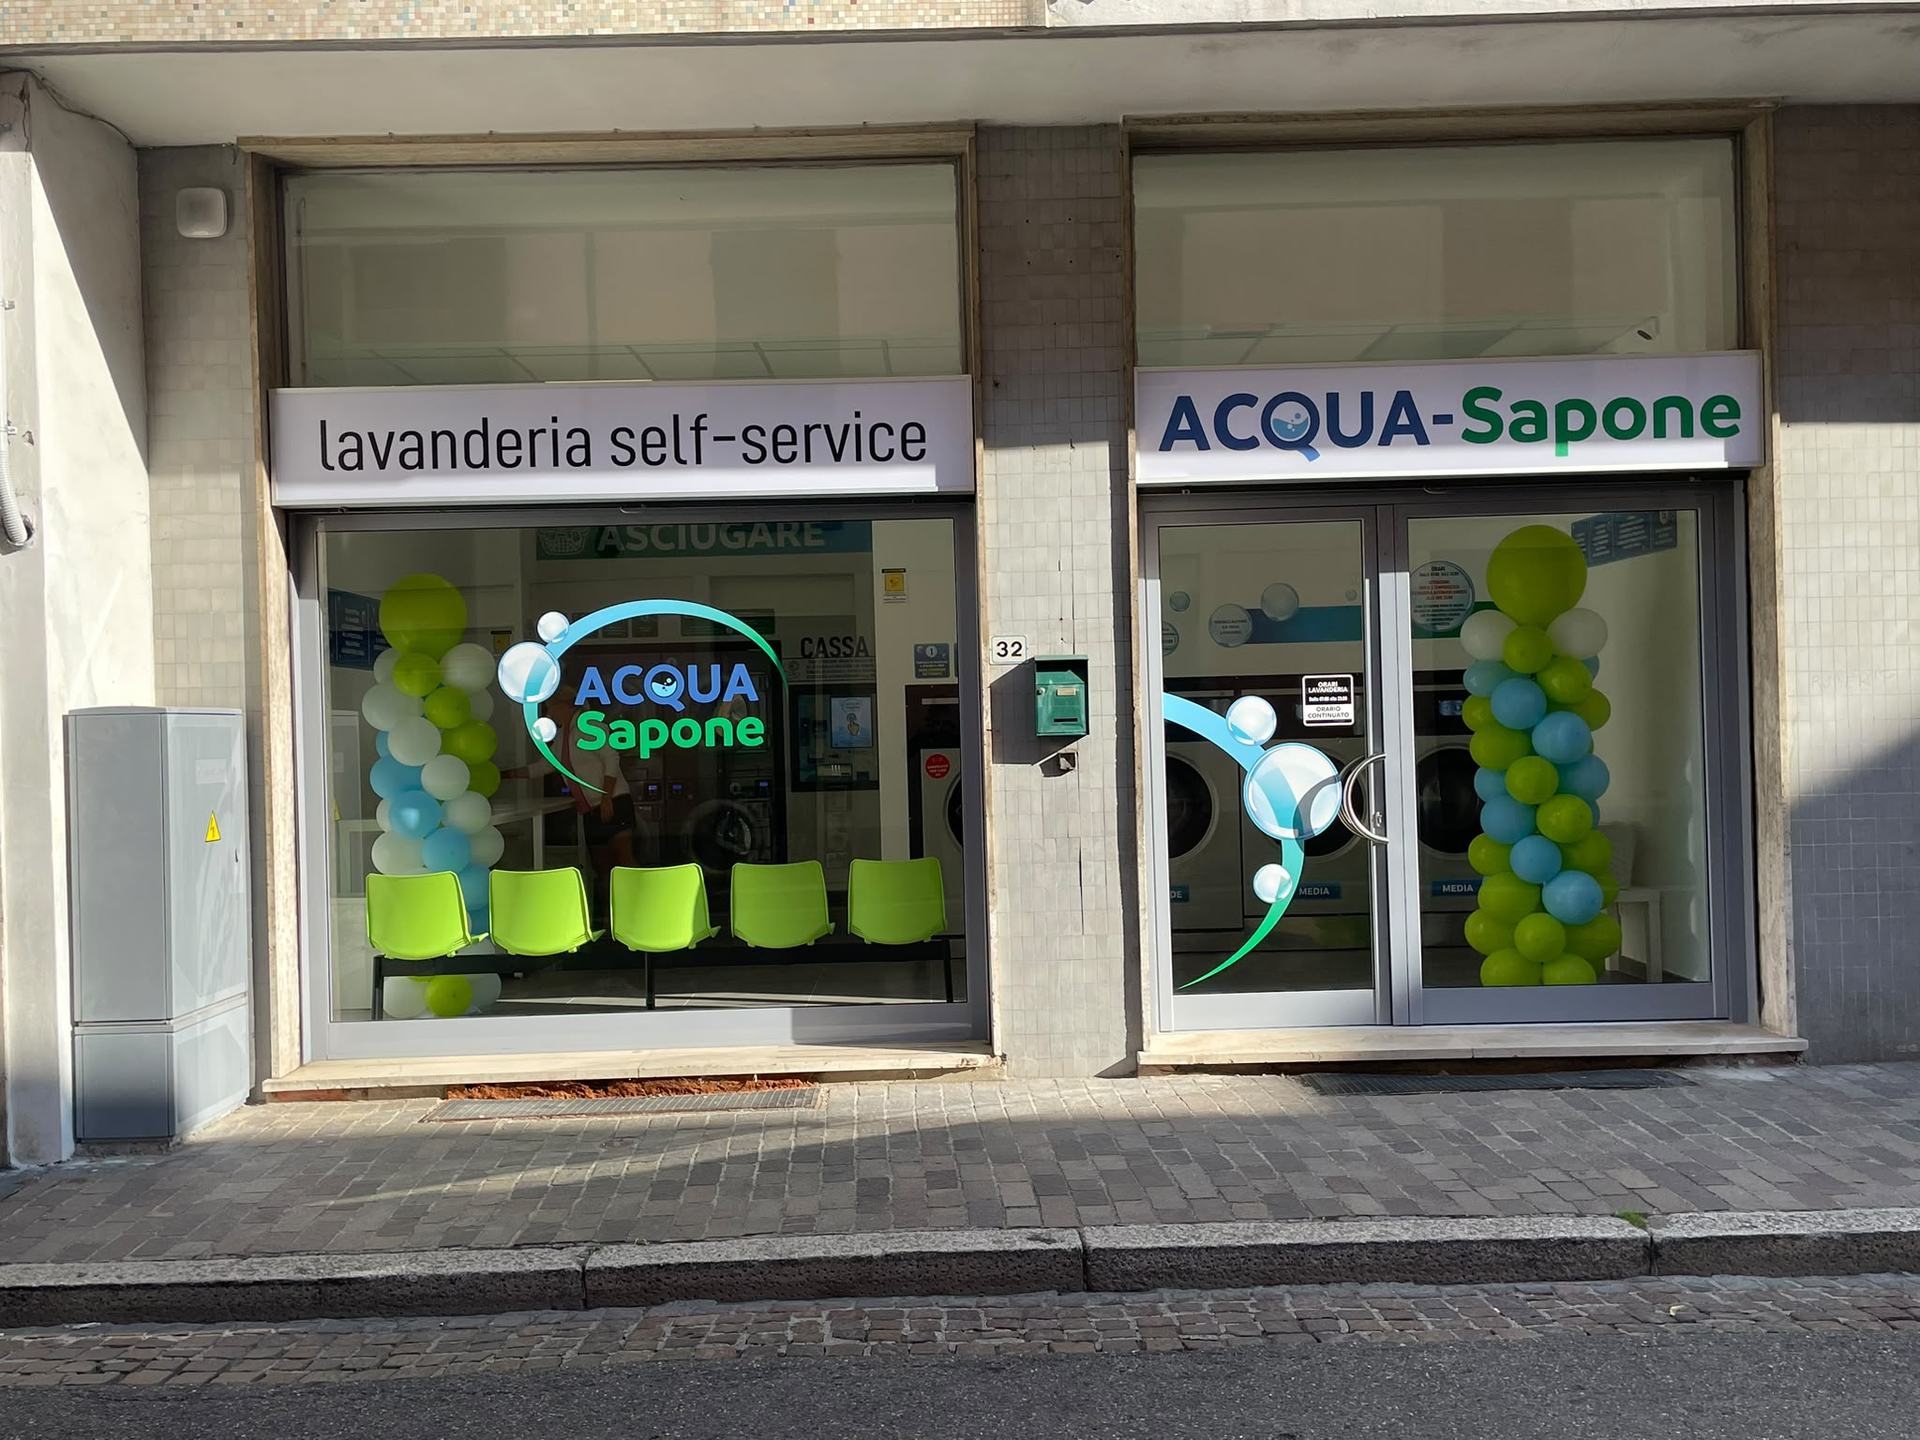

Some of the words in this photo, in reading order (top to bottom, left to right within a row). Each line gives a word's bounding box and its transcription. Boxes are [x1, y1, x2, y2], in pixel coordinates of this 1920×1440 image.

[1159, 386, 1742, 462] ACQUA-Sapone
[320, 416, 592, 471] lavanderia
[611, 411, 928, 468] self-service
[599, 522, 826, 550] ASCIUGARE
[800, 636, 869, 658] CASSA
[996, 641, 1023, 658] 32
[574, 662, 760, 713] ACQUA
[576, 709, 766, 760] Sapone
[1299, 887, 1330, 896] MEDIA
[1442, 884, 1474, 893] MEDIA
